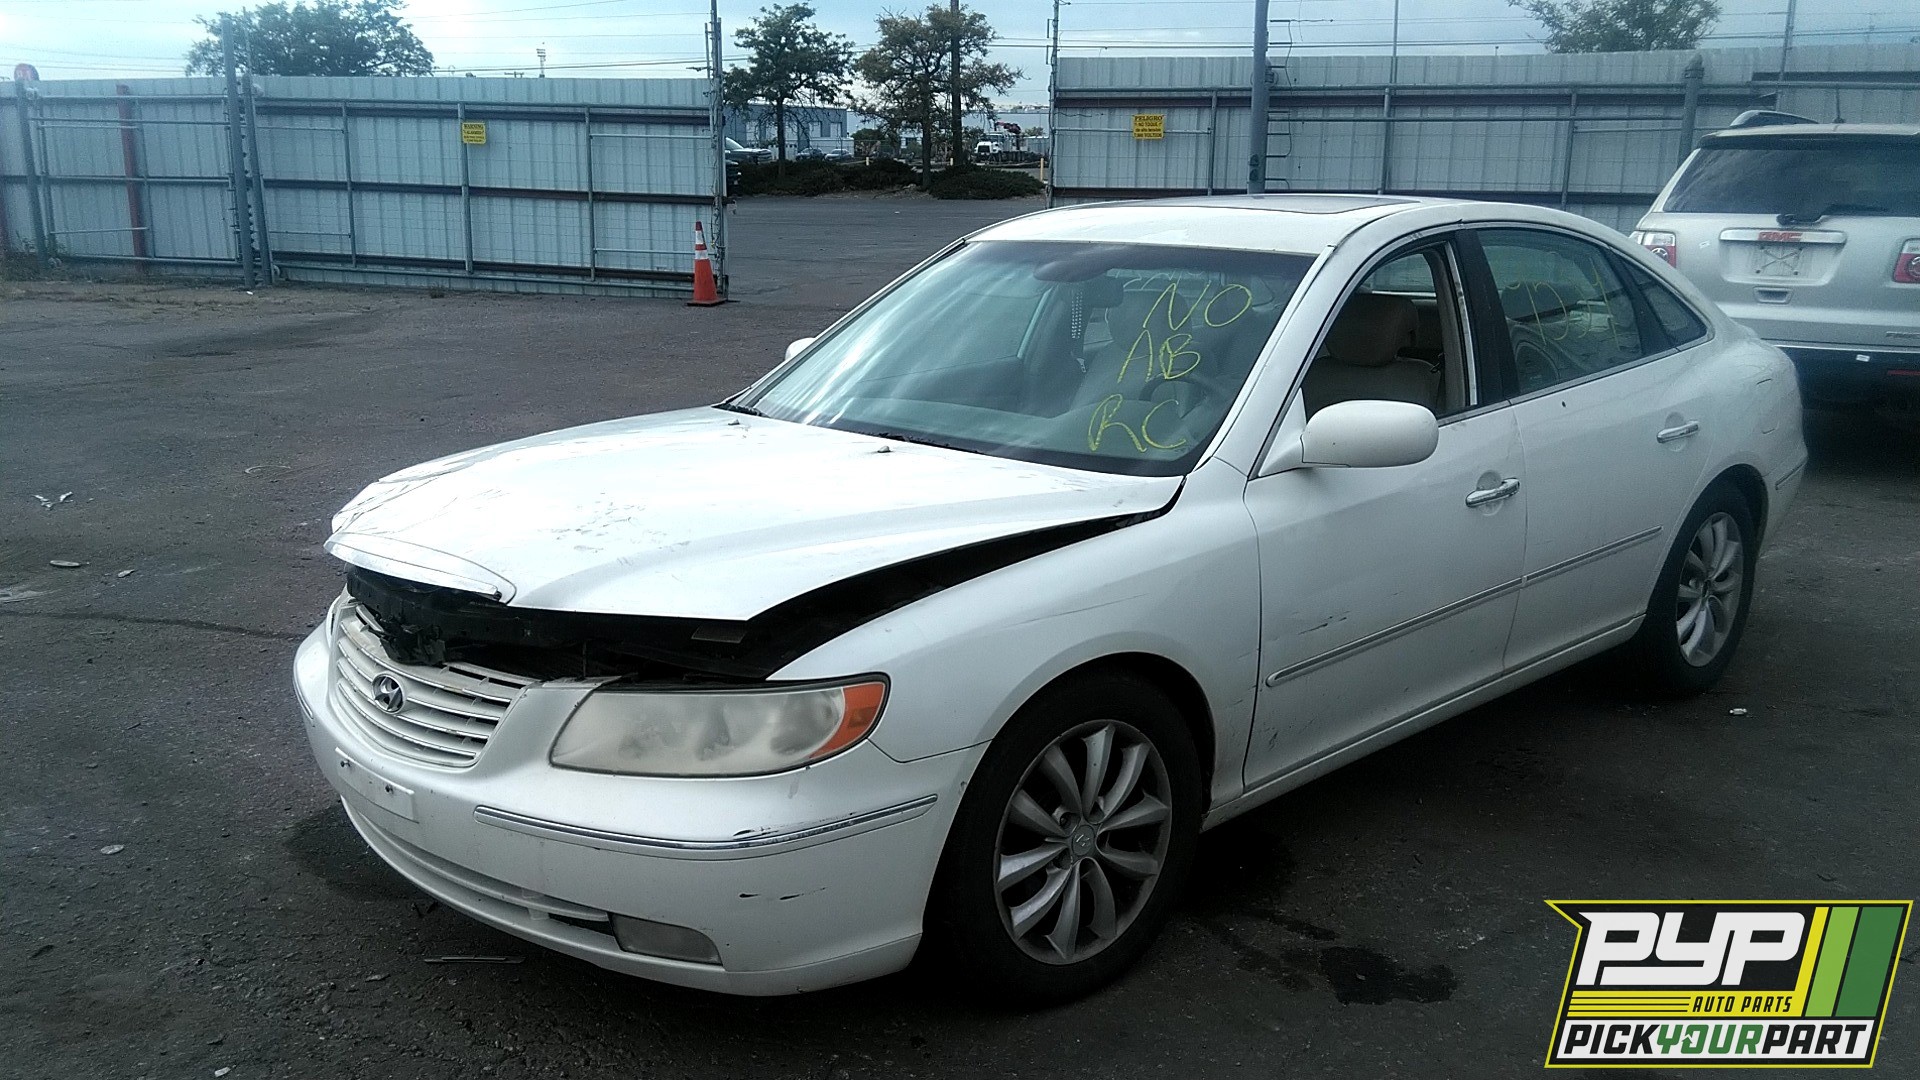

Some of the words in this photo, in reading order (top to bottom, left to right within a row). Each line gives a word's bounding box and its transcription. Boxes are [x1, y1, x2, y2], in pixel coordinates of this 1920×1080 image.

[1758, 231, 1803, 242] GMC
[1143, 280, 1252, 331] NO
[1117, 329, 1200, 383] AB
[1088, 393, 1187, 452] RC
